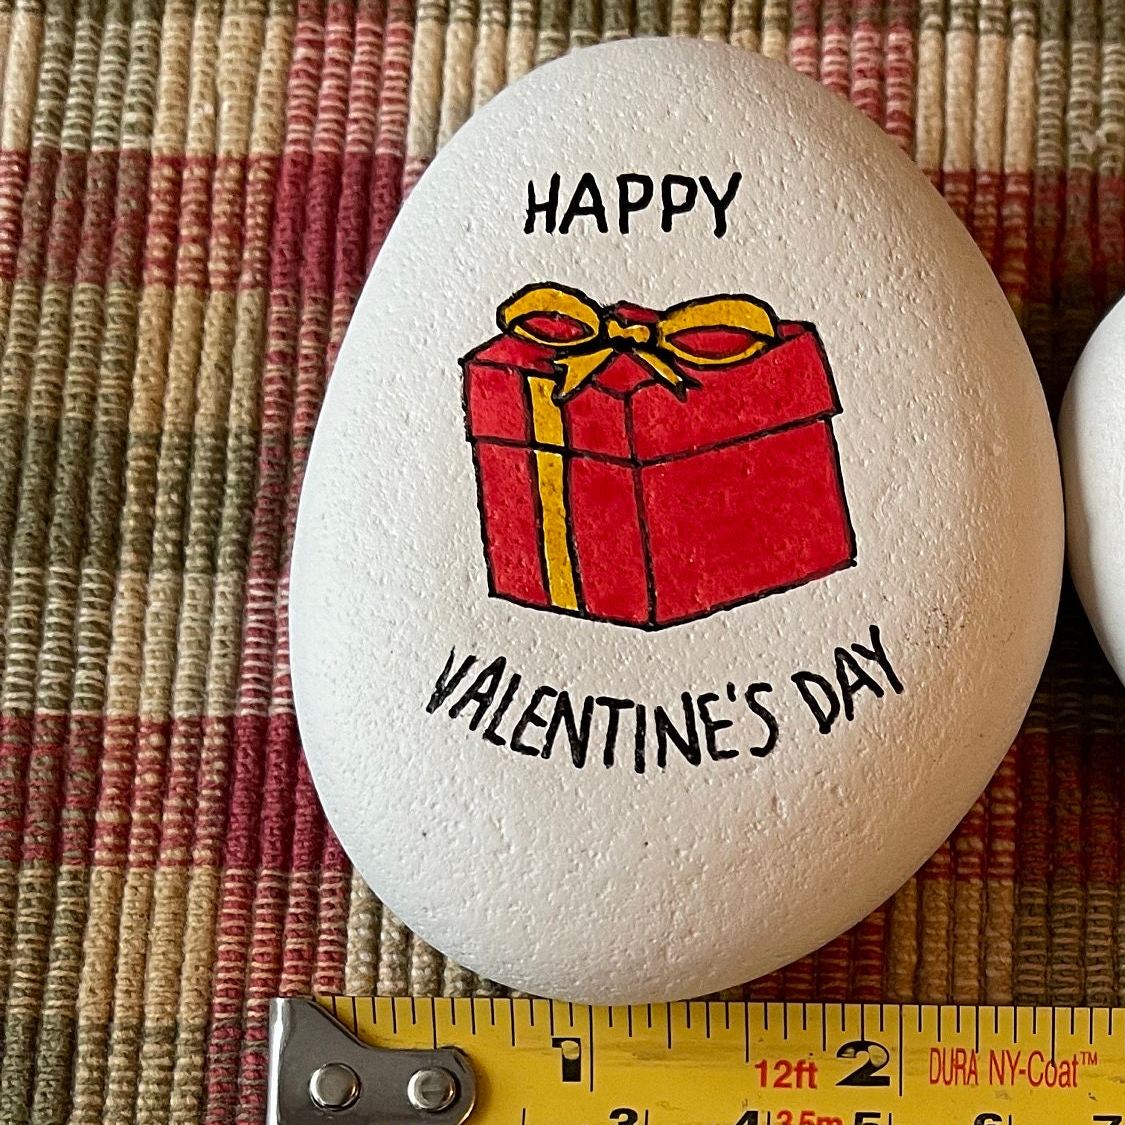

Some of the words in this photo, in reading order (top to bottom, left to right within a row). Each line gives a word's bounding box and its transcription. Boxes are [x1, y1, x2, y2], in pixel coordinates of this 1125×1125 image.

[524, 172, 742, 237] HAPPY
[426, 646, 778, 773] VALENTINE'S
[791, 625, 905, 734] DAY
[755, 1059, 818, 1089] 12ft
[836, 1040, 891, 1087] 2
[929, 1048, 980, 1085] DURA
